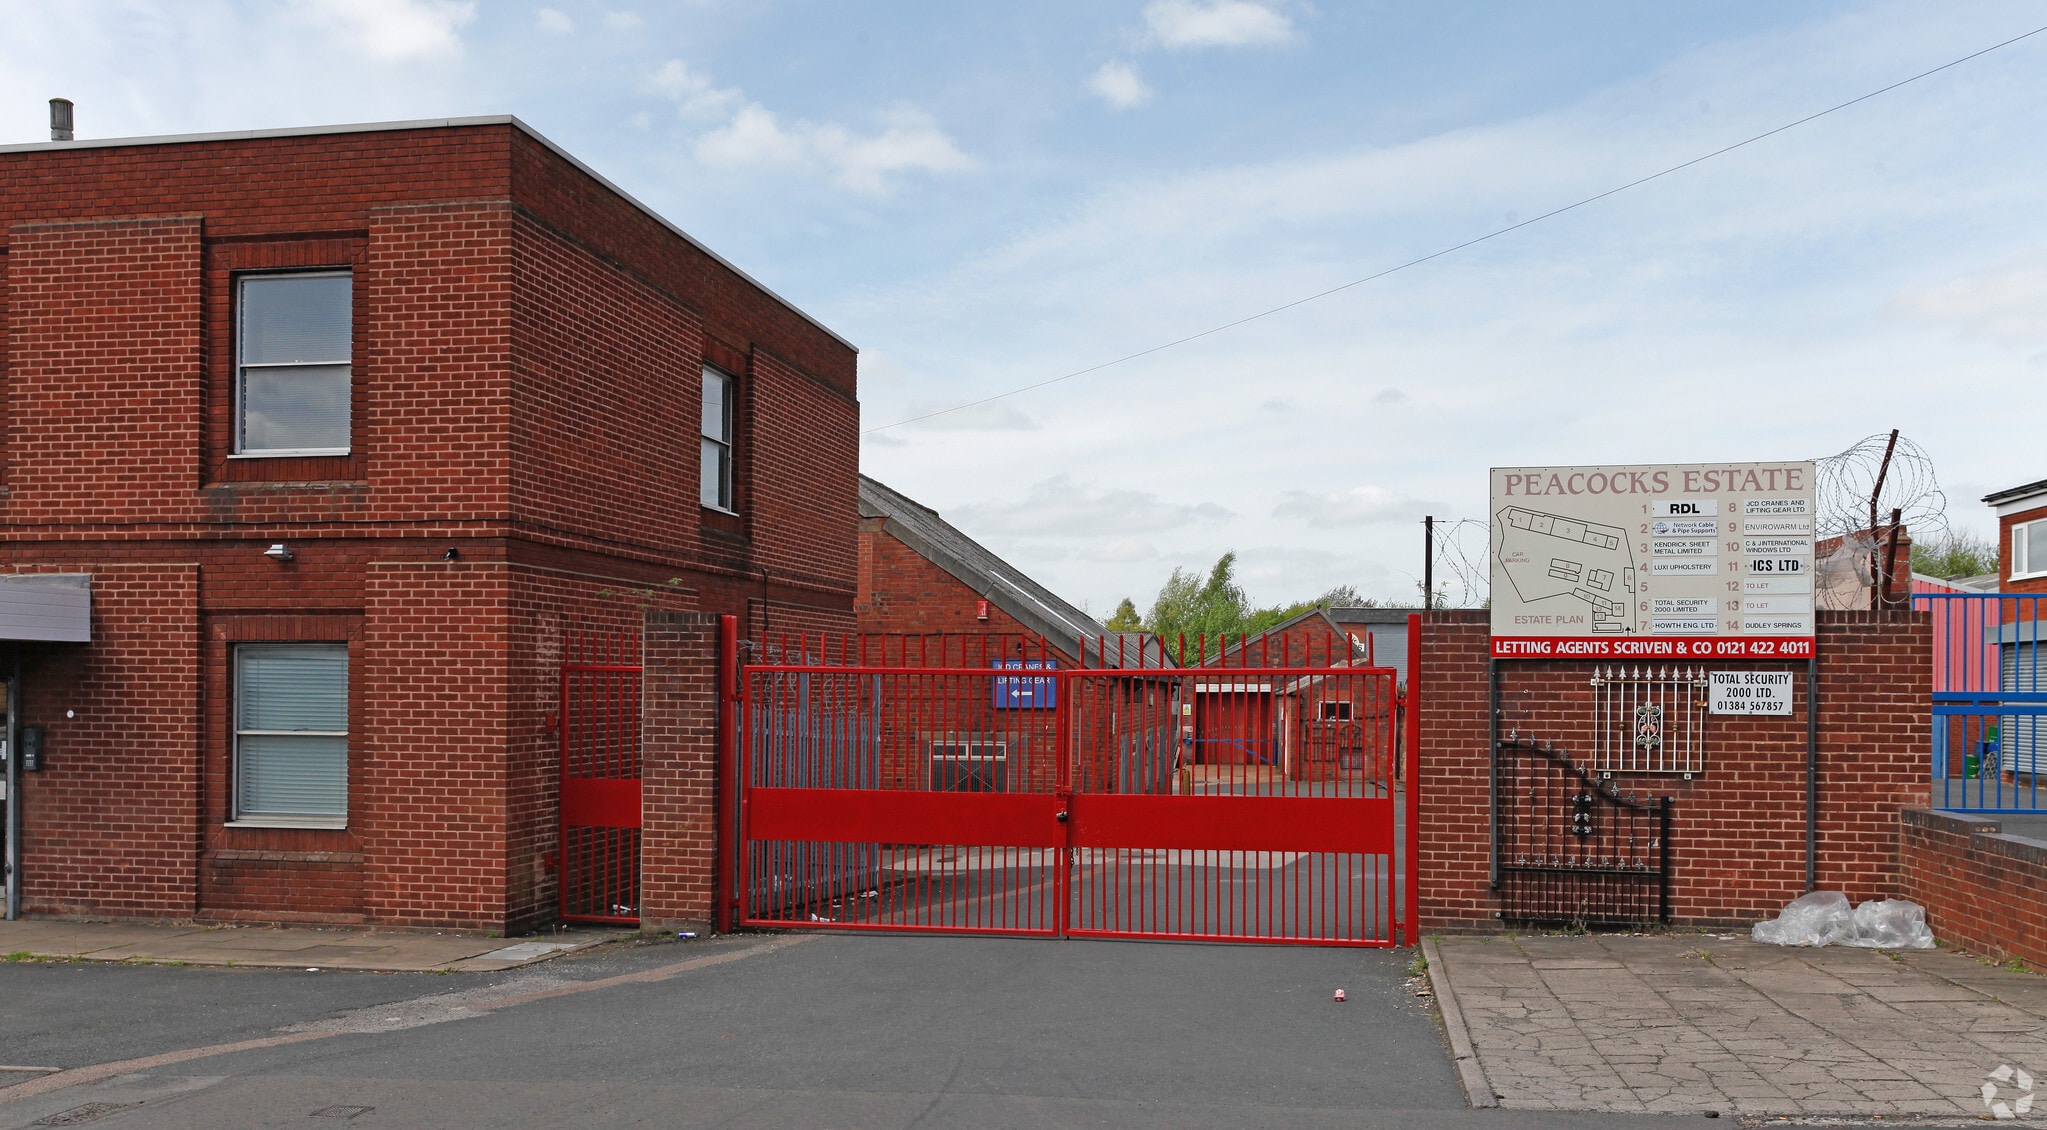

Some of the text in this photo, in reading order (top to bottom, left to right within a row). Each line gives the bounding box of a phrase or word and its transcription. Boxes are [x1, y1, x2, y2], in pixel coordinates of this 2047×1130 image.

[1504, 468, 1804, 496] PEACOCKS ESTATE
[1641, 504, 1647, 514] 1
[1670, 503, 1700, 514] RDL
[1728, 502, 1736, 512] 8
[1640, 523, 1648, 534] 2
[1728, 522, 1737, 532] 9
[1640, 543, 1648, 553] 3
[1726, 542, 1739, 552] 10
[1640, 562, 1648, 572] 4
[1728, 562, 1738, 571] 11
[1753, 559, 1799, 571] ICS LTD
[1640, 582, 1648, 592] 5
[1726, 581, 1739, 591] 12
[1640, 601, 1648, 611] 6
[1726, 601, 1739, 611] 13
[1515, 615, 1584, 624] ESTATE PLAN
[1640, 621, 1648, 631] 7
[1726, 620, 1739, 630] 14
[1496, 641, 1810, 654] LETTING AGENTS SCRIVEN & CO 0121 422 4011
[1713, 674, 1789, 685] TOTAL SECURITY
[1726, 687, 1775, 698] 2000 LTD.
[1717, 701, 1784, 711] 01384 567857
